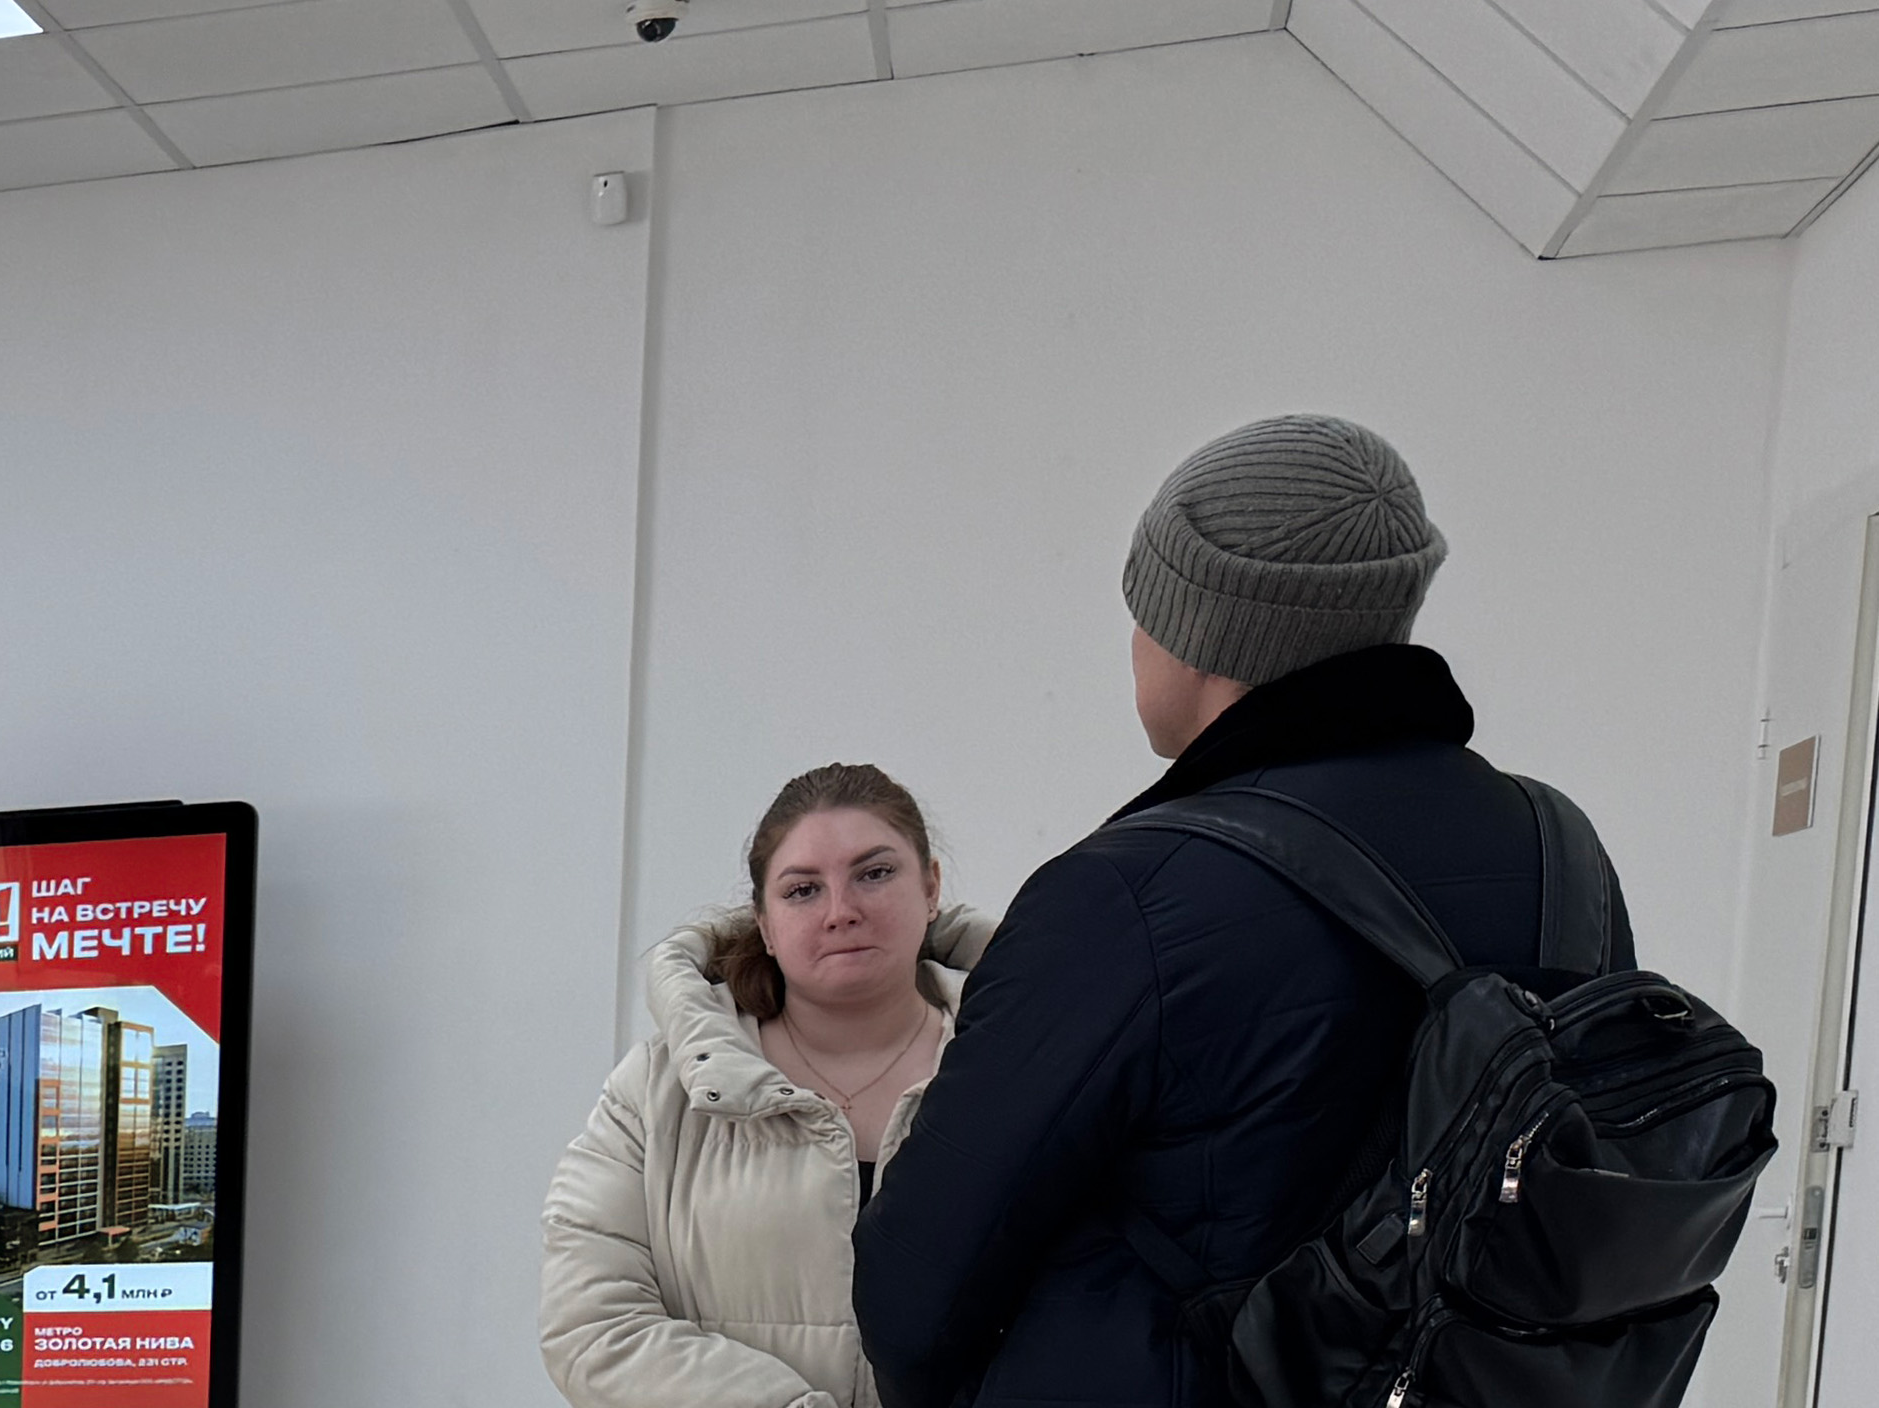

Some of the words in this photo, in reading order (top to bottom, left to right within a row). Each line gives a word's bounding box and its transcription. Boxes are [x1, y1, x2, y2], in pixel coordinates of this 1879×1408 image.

[31, 877, 91, 898] ШАГ
[31, 905, 69, 924] НА
[75, 897, 207, 922] ВСТРЕЧУ
[31, 923, 207, 961] МЕЧТЕ!
[62, 1273, 116, 1303] 4,1
[122, 1289, 157, 1299] МЛН
[34, 1327, 83, 1337] МЕТРО
[34, 1337, 131, 1351] ЗОЛОТАЯ
[135, 1337, 195, 1350] НИВА
